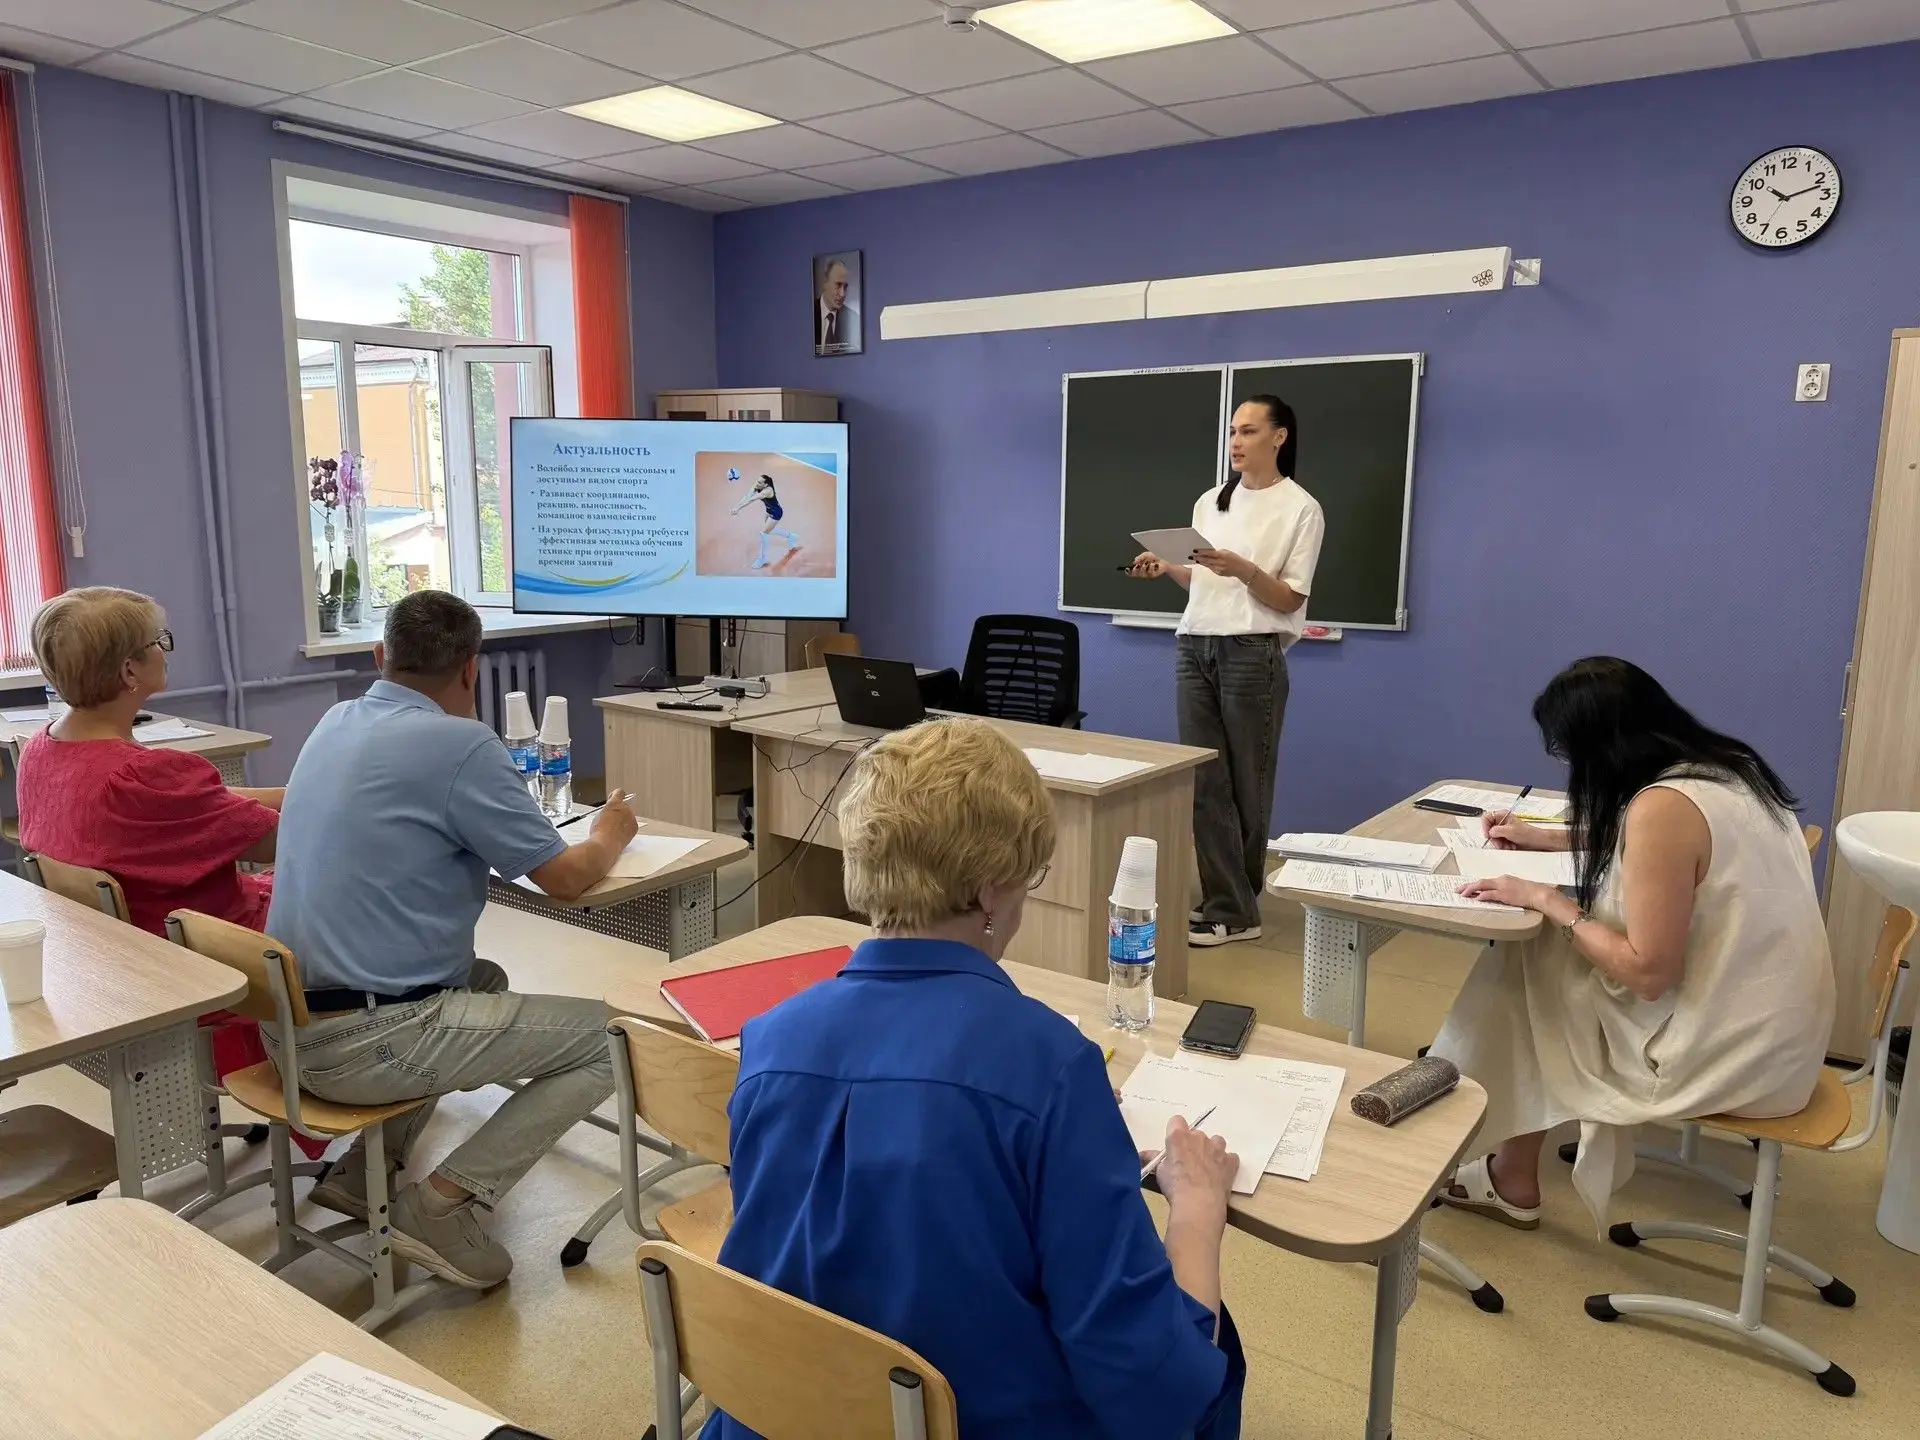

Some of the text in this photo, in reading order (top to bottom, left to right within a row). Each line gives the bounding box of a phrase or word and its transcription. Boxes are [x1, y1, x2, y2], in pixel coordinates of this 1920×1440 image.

[1781, 157, 1797, 169] 12
[1805, 160, 1811, 172] 1
[1764, 164, 1776, 176] 11
[1748, 178, 1764, 190] 10
[1815, 172, 1825, 184] 2
[1819, 188, 1831, 200] 3
[1741, 196, 1752, 207] 9
[1746, 213, 1757, 224] 8
[1811, 207, 1822, 218] 4
[1760, 223, 1769, 235] 7
[1796, 220, 1807, 232] 5
[1775, 227, 1788, 239] 6
[553, 443, 650, 457] Актуальность
[537, 464, 578, 473] Волейбол
[580, 466, 620, 474] является
[537, 477, 586, 485] доступным
[540, 490, 649, 500] Развивает координацию,
[537, 502, 646, 511] реакцию, выносливость,
[586, 513, 656, 521] взаимодействие
[538, 525, 689, 537] На уроках физкультуры требуется
[539, 536, 683, 548] эффективная методика обучения
[575, 549, 591, 557] при
[594, 550, 657, 558] ограниченном
[539, 558, 613, 567] времени занятий
